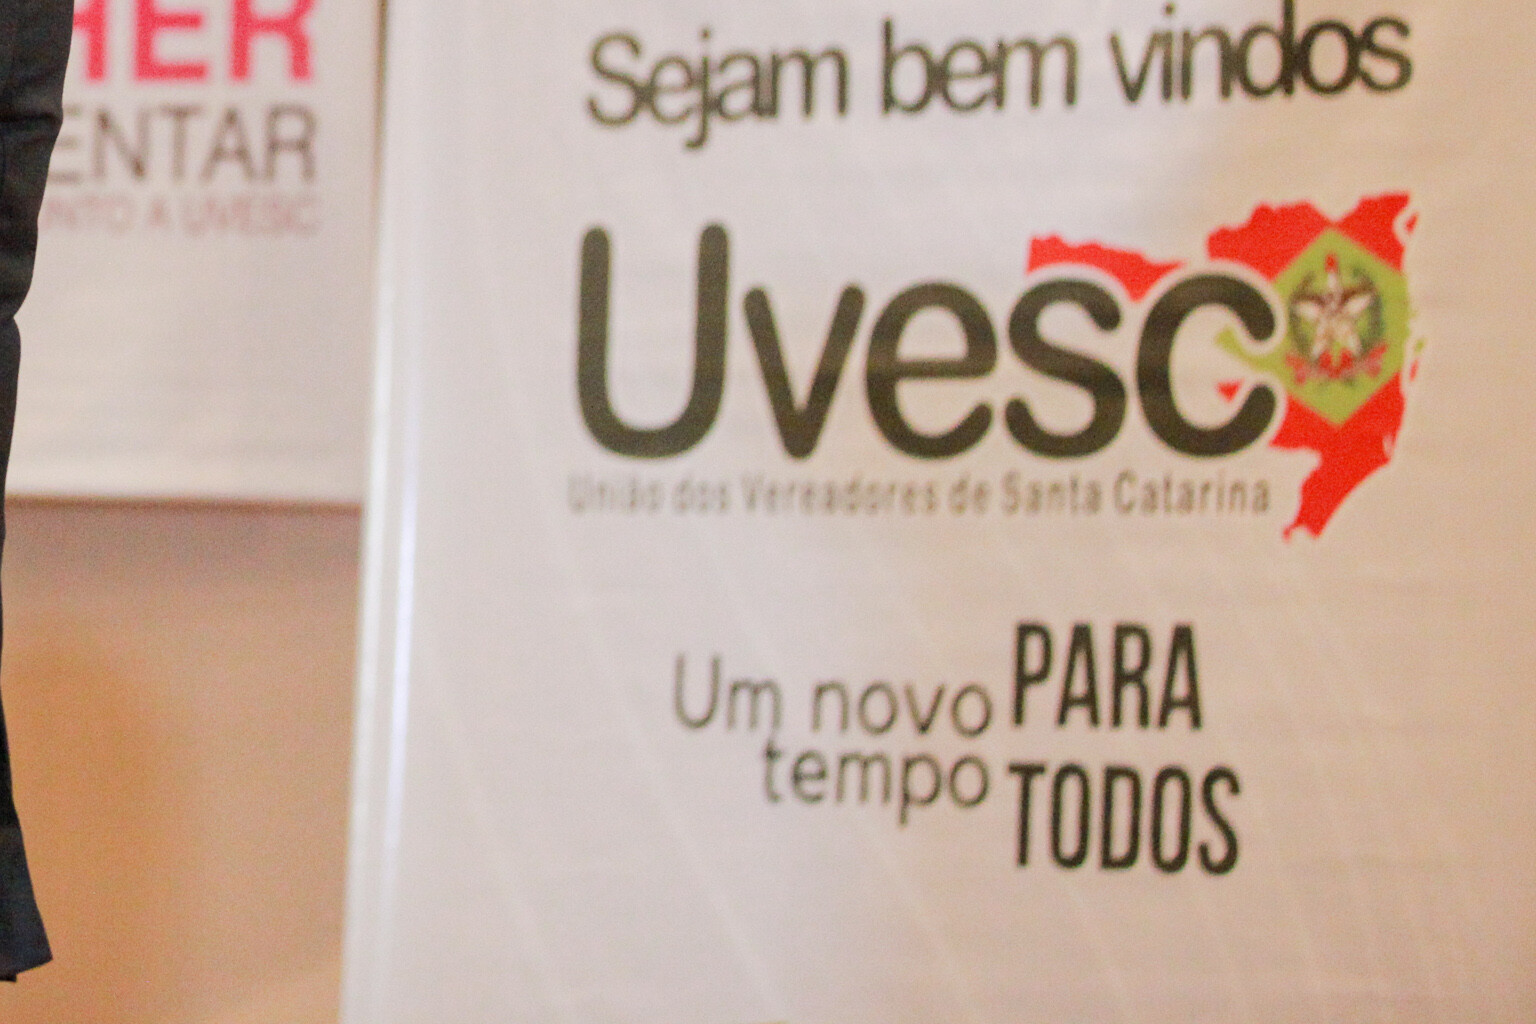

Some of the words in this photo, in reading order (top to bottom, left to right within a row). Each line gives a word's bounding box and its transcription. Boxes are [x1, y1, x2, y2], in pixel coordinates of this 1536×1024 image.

[586, 28, 850, 152] Sejam
[882, 16, 1079, 115] bem
[576, 223, 1279, 461] Uvesc
[566, 475, 664, 516] União
[671, 476, 730, 515] dos
[739, 473, 939, 516] Vereadores
[948, 474, 990, 515] de
[1000, 472, 1103, 515] Santa
[1114, 470, 1270, 515] Catarina
[672, 652, 782, 731] Um
[811, 681, 992, 737] novo
[1010, 622, 1203, 730] PARA
[763, 739, 991, 827] tempo
[1008, 764, 1241, 875] TODOS
